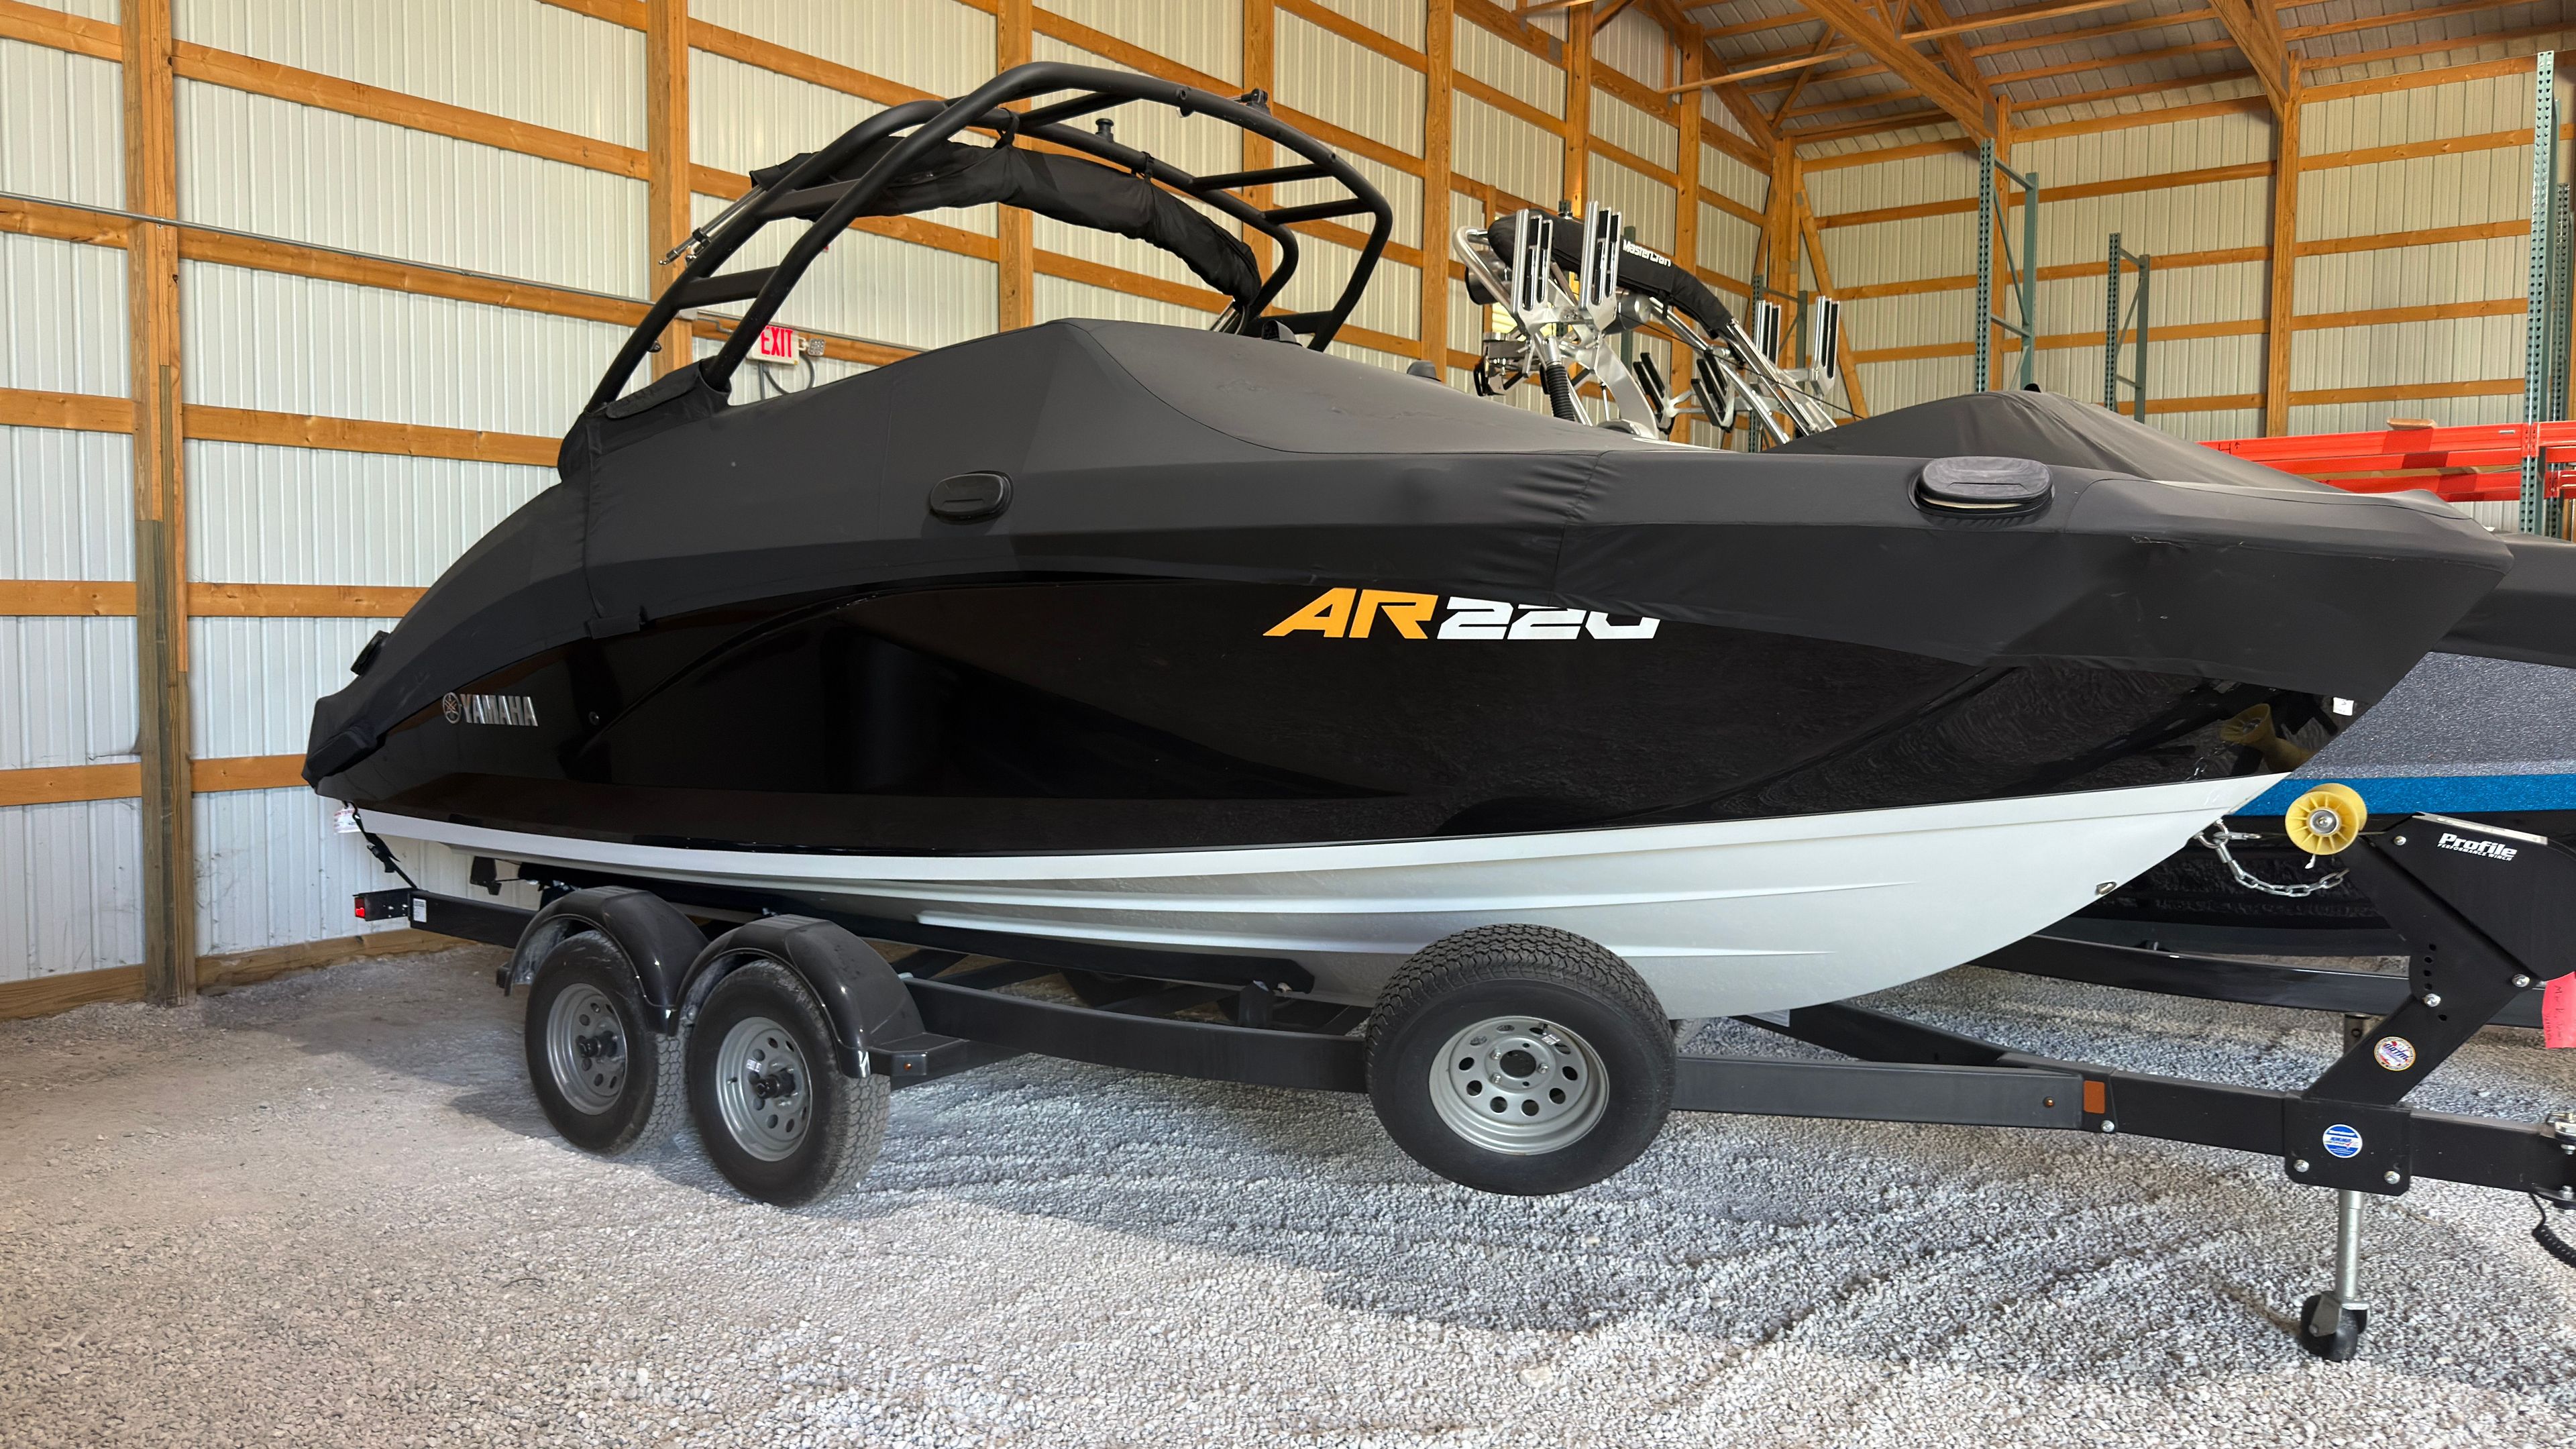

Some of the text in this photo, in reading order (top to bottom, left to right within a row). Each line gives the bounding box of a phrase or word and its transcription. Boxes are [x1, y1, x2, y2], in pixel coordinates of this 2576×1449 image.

[761, 326, 794, 358] EXIT
[460, 694, 538, 727] YAMAHA
[2437, 843, 2512, 861] PERFORMANCE WINCH
[2438, 833, 2518, 857] Profile
